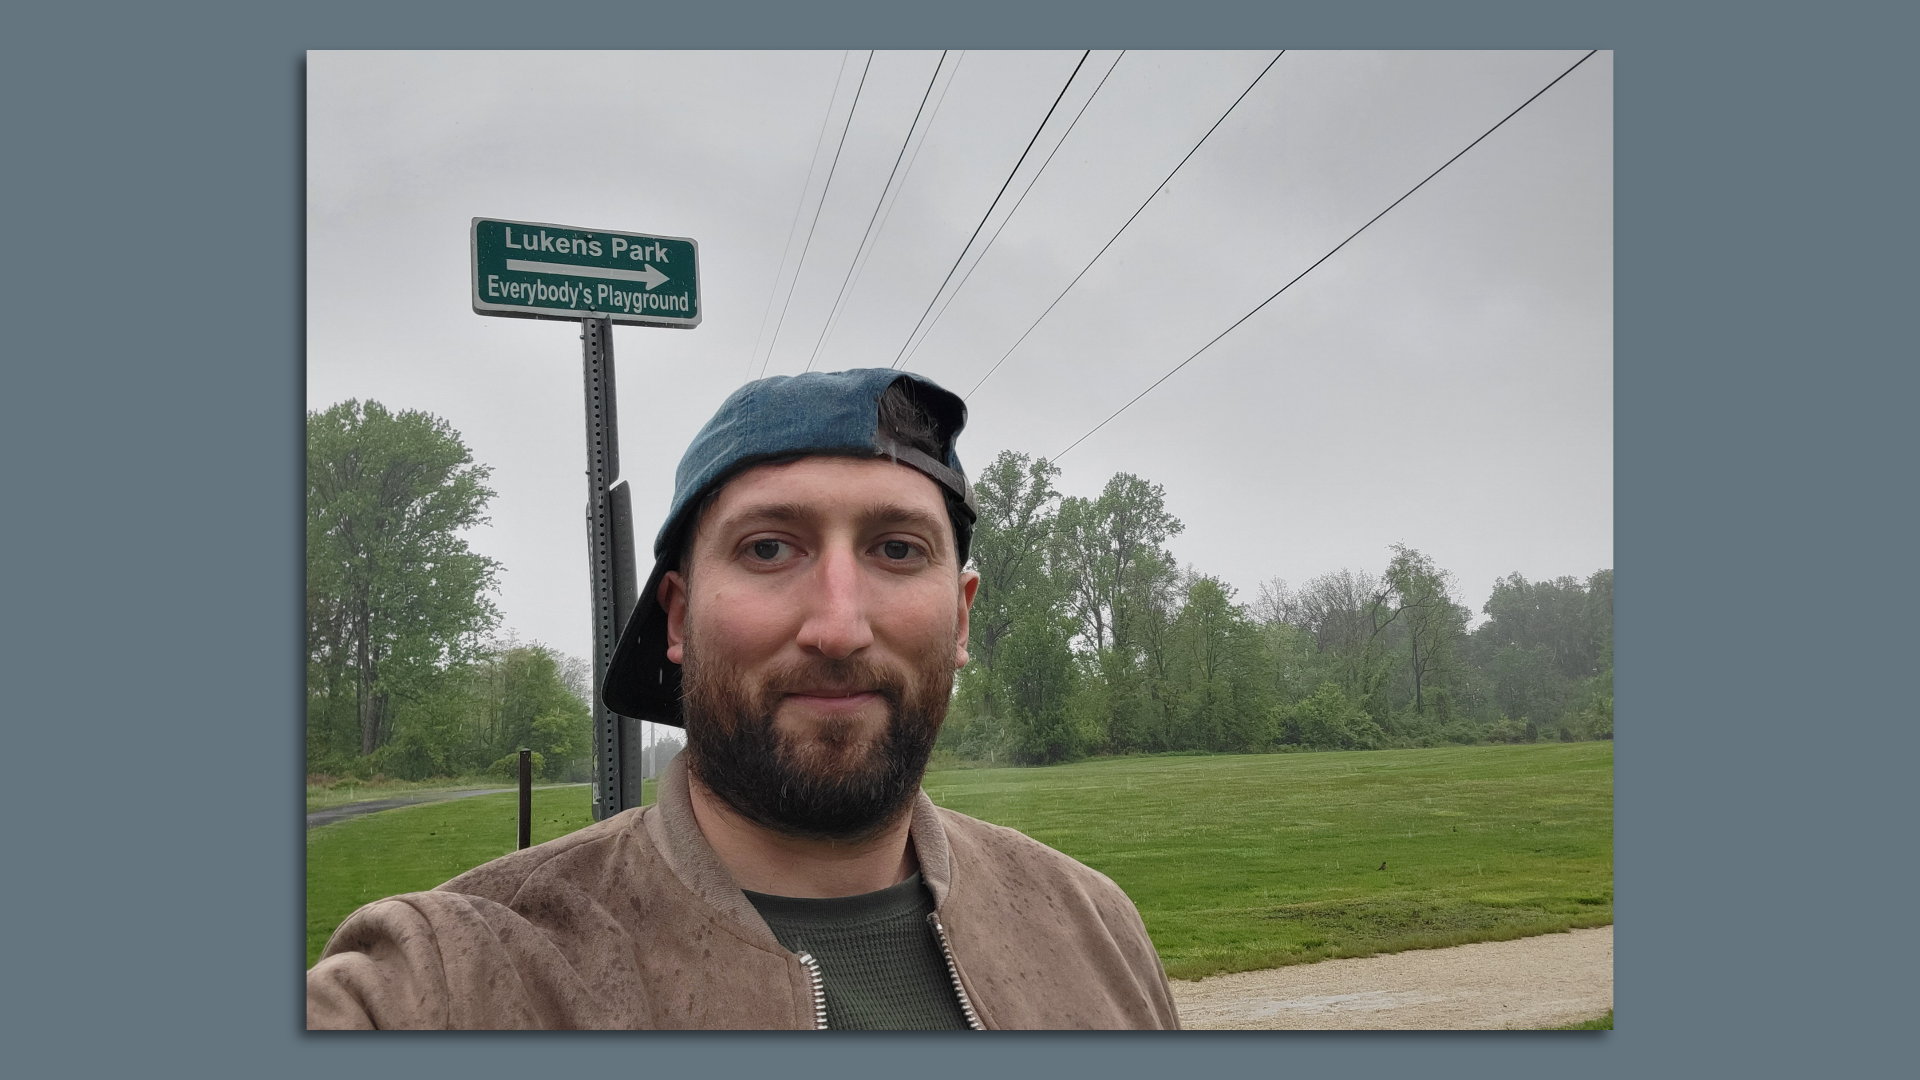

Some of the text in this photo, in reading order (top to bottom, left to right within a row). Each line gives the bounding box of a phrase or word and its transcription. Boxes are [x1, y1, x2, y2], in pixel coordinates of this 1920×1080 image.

[505, 226, 670, 264] Lukens Park
[487, 274, 689, 314] Everybody's Playground
